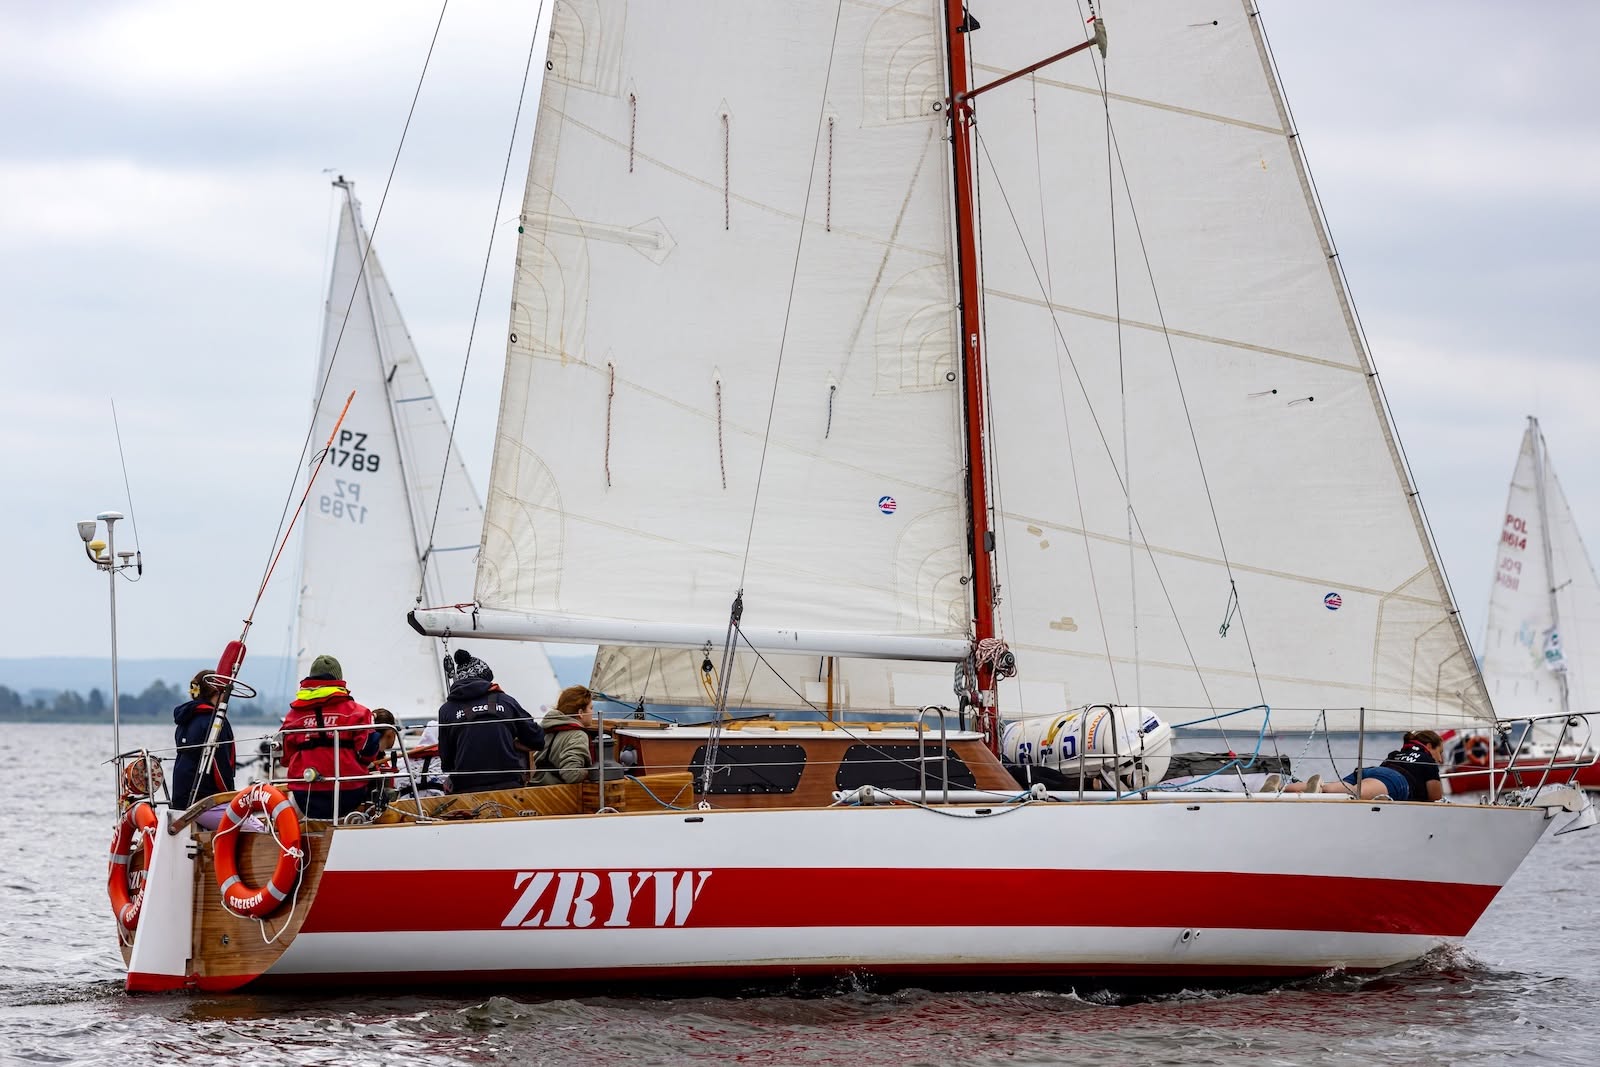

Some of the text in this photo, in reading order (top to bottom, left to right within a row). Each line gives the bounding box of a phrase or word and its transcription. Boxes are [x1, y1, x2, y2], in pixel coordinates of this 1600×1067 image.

[339, 429, 368, 451] PZ
[329, 447, 380, 472] 1789
[1505, 514, 1528, 534] POL
[303, 715, 339, 728] SKUT
[229, 891, 263, 910] SZCZECIN
[500, 871, 712, 927] ZRYW
